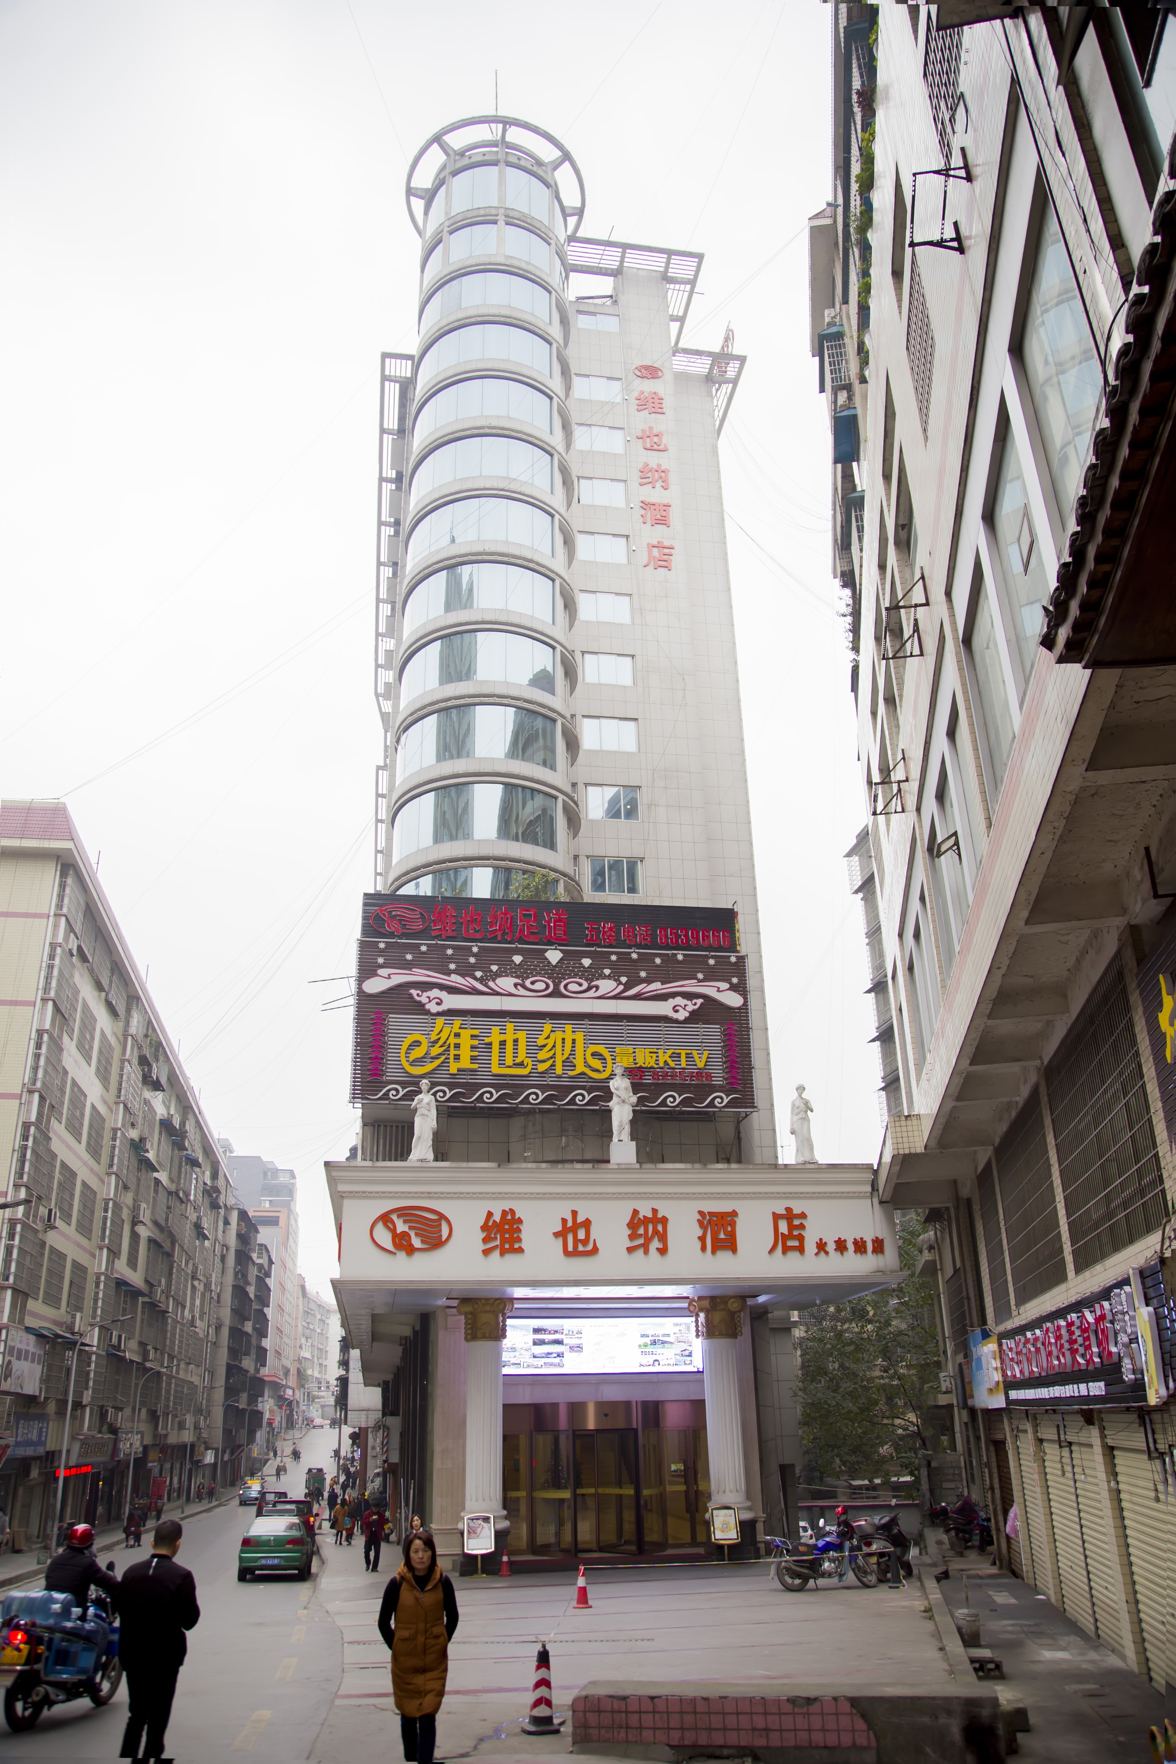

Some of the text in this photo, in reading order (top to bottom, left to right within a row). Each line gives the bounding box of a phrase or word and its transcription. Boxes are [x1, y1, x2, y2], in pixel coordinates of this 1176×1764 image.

[635, 389, 675, 571] 维也纳酒店
[431, 903, 569, 943] 维也纳足道
[584, 921, 731, 948] 五楼 电话 8539666
[400, 1018, 613, 1080] 维也纳
[614, 1047, 709, 1068] 量贩KTV
[651, 1070, 713, 1082] 8225788
[480, 1206, 808, 1256] 维也纳酒店
[814, 1236, 886, 1256] 火车站店
